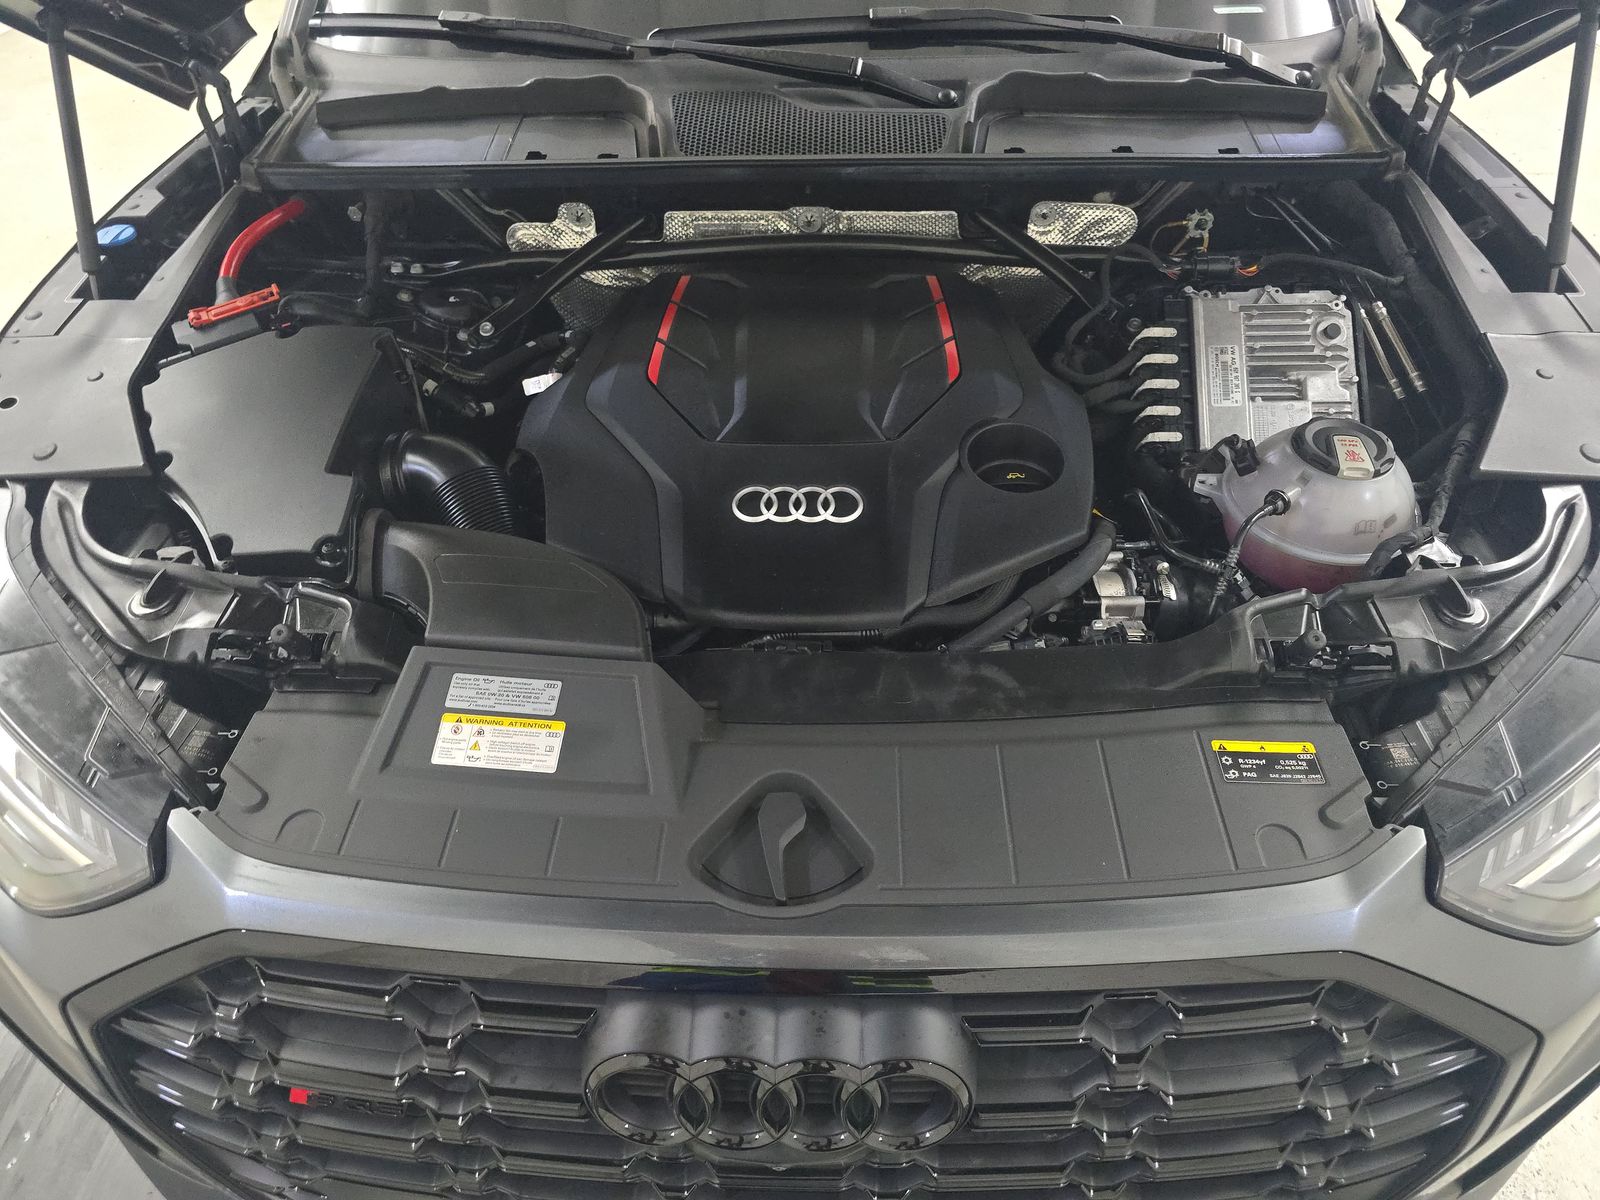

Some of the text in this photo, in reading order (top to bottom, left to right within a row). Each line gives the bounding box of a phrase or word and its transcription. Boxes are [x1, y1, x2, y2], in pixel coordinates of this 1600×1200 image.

[465, 717, 552, 730] WARNING ATTENTION
[1238, 758, 1266, 766] R-1234yf
